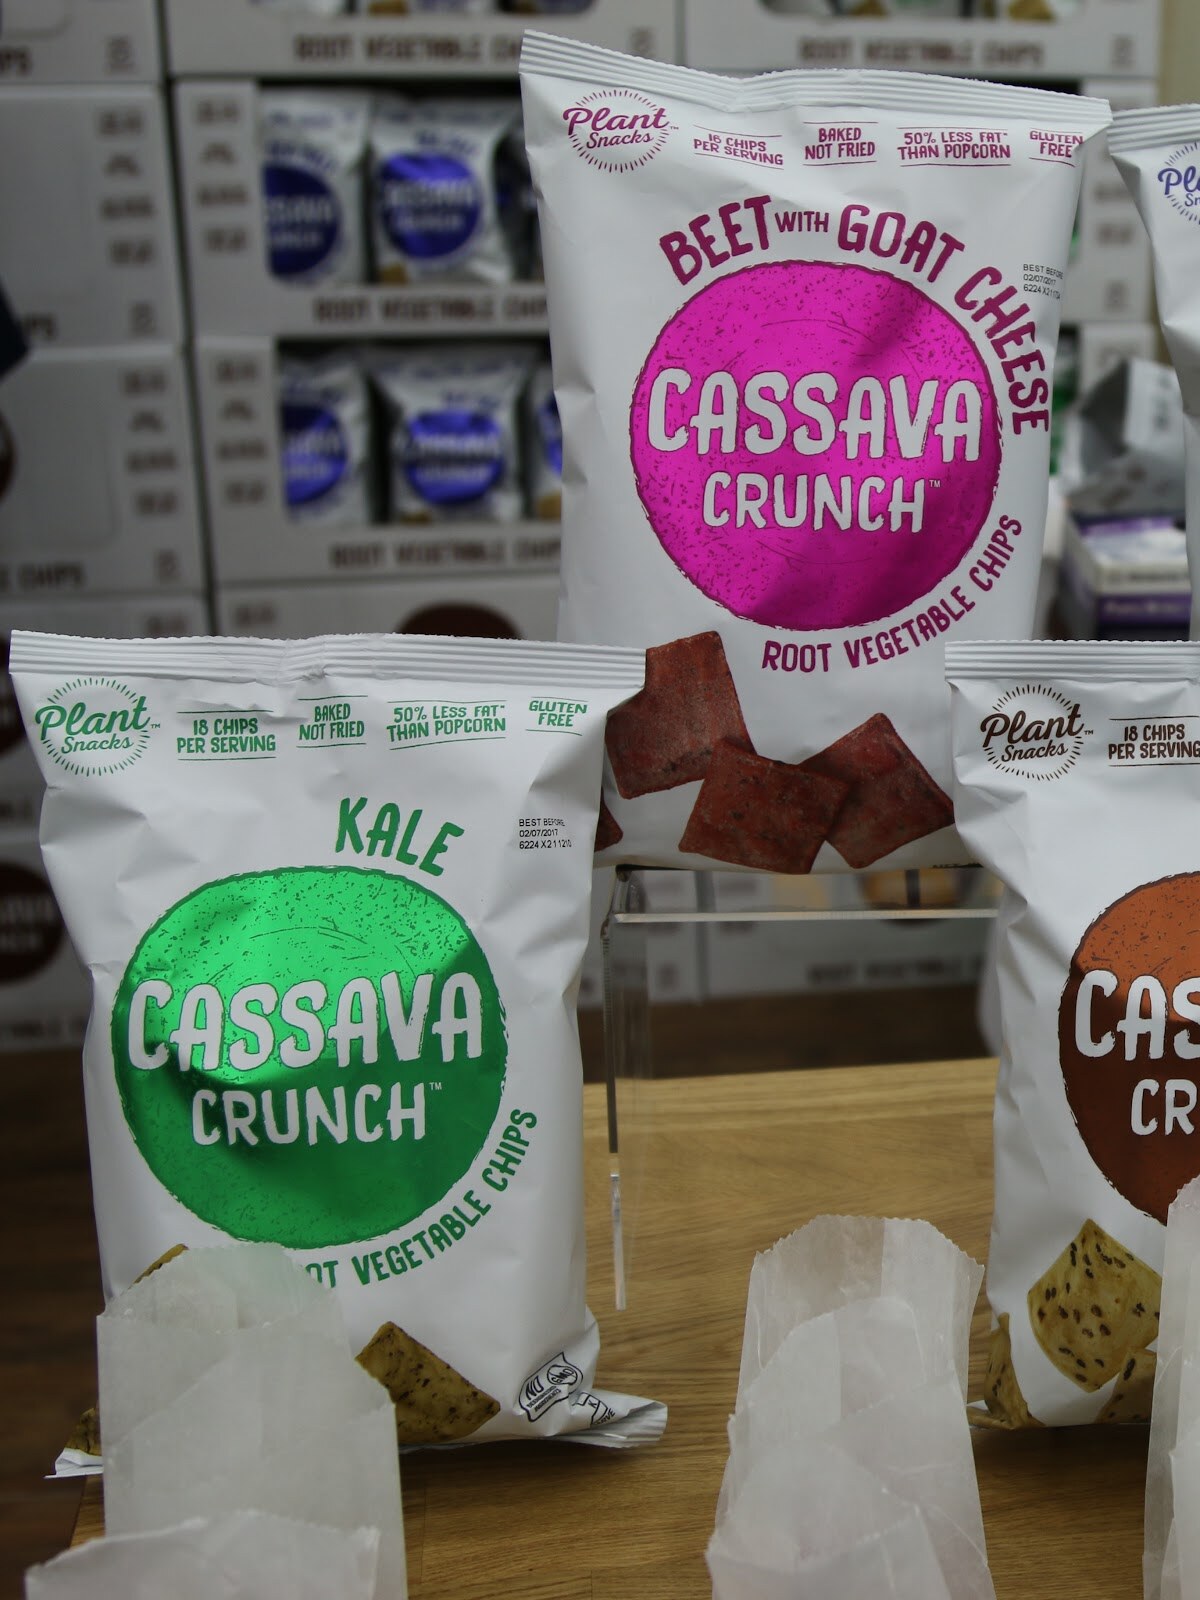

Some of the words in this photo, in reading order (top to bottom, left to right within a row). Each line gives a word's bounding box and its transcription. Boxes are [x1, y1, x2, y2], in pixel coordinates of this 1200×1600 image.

[562, 107, 669, 136] Plant
[586, 130, 654, 149] Snacks
[726, 137, 766, 152] CHIPS
[818, 127, 861, 143] BAKED
[903, 132, 937, 145] 50%
[941, 131, 973, 144] LESS
[1029, 130, 1084, 145] GLUTEN
[693, 138, 719, 153] PER
[724, 146, 783, 165] SERVING
[804, 143, 831, 160] NOT
[837, 141, 876, 158] FRIED
[897, 145, 939, 160] THAN
[944, 143, 1011, 159] POPCORN
[1039, 142, 1073, 158] FREE
[1023, 263, 1044, 272] BEST
[659, 195, 772, 285] BEET
[774, 210, 829, 235] WITH
[837, 203, 965, 283] GOAT
[954, 266, 1049, 436] CHEESE
[647, 367, 983, 463] CASSAVA
[702, 471, 925, 532] CRUNCH
[761, 639, 831, 673] ROOT
[844, 585, 975, 669] VEGETABLE
[969, 514, 1022, 592] CHIPS
[314, 702, 351, 723] BAKED
[393, 706, 427, 723] 50%
[432, 705, 467, 720] LESS
[528, 699, 588, 715] GLUTEN
[34, 695, 151, 741] Plant
[193, 719, 209, 736] 18
[213, 717, 259, 735] CHIPS
[537, 711, 574, 727] FREE
[980, 703, 1084, 748] Plant
[299, 722, 327, 741] NOT
[329, 720, 365, 739] FRIED
[386, 721, 429, 742] THAN
[434, 717, 506, 736] POPCORN
[1124, 725, 1139, 742] 18
[1142, 723, 1186, 742] CHIPS
[61, 733, 134, 754] Snacks
[176, 736, 206, 754] PER
[210, 734, 276, 753] SERVING
[1001, 739, 1068, 763] Snacks
[1108, 743, 1135, 760] PER
[518, 818, 541, 827] BEST
[335, 796, 465, 877] KALE
[519, 828, 558, 838] 02/07/2017
[519, 840, 539, 850] 6224
[127, 971, 483, 1071] CASSAVA
[191, 1081, 426, 1147] CRUNCH
[305, 1260, 339, 1288] OT
[351, 1190, 491, 1286] VEGETABLE
[481, 1108, 538, 1192] CHIPS
[525, 1375, 545, 1401] NO
